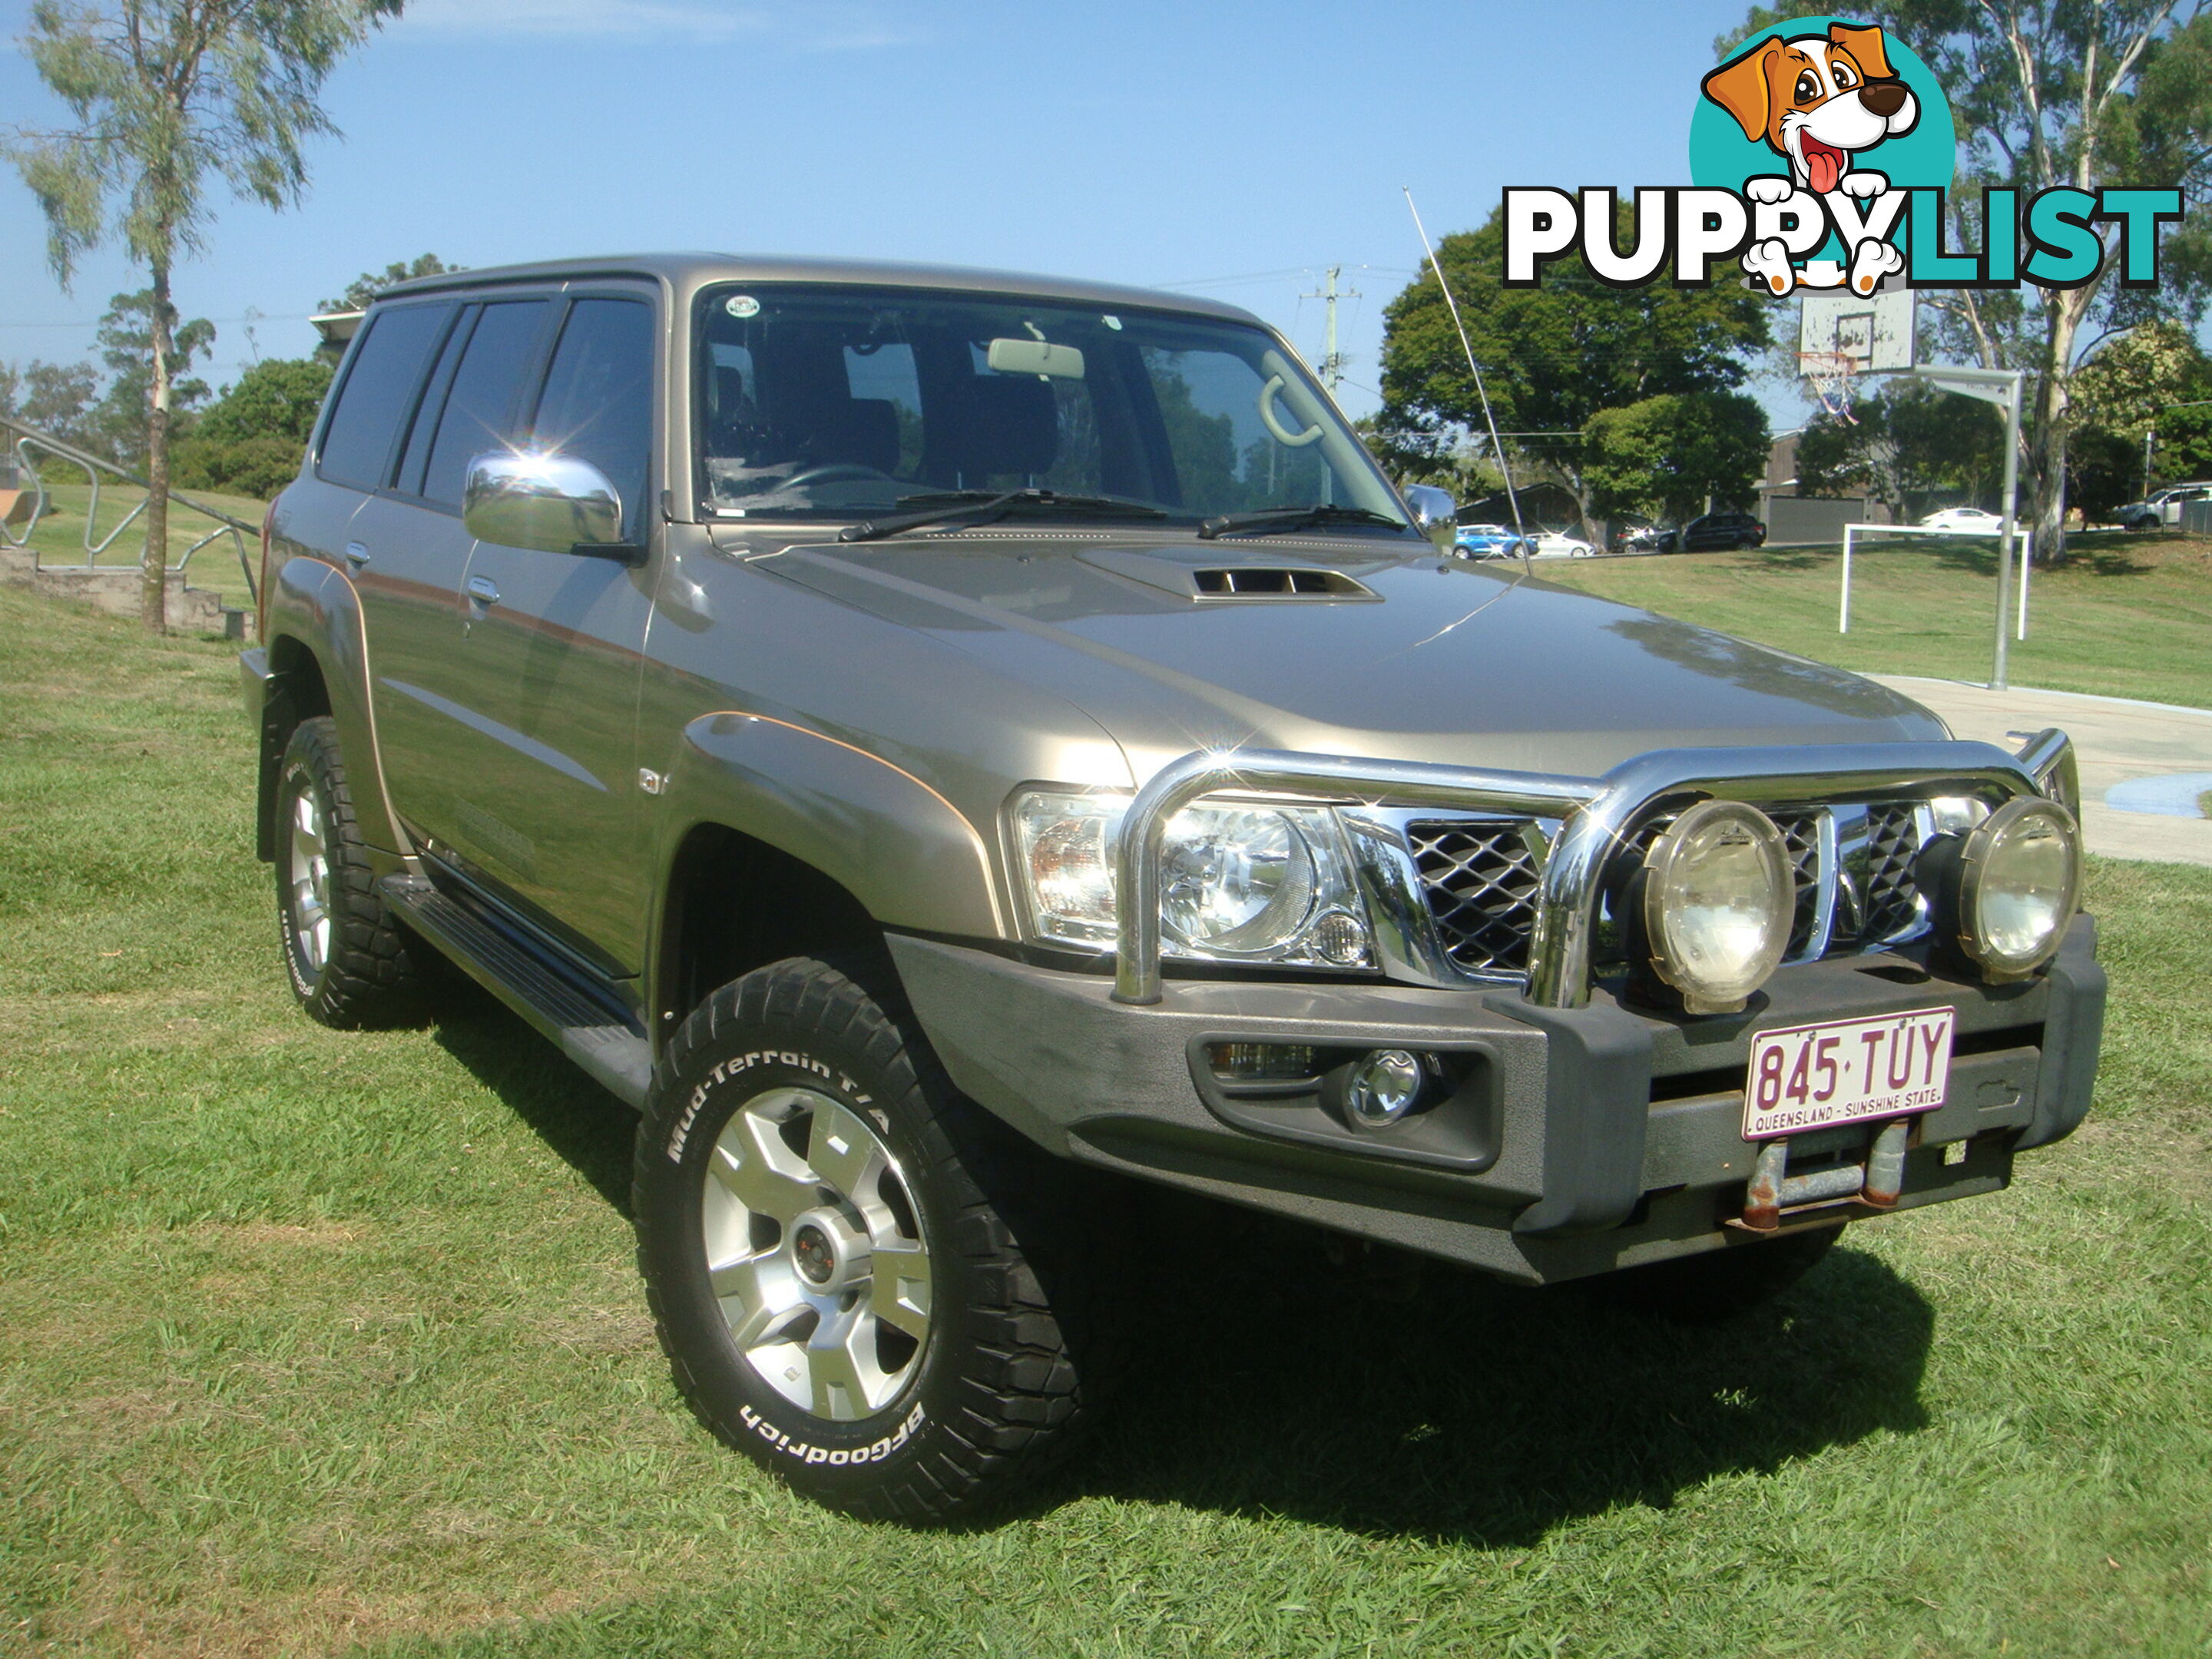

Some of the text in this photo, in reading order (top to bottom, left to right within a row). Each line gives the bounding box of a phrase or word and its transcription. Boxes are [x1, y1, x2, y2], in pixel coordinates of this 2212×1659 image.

[667, 1050, 890, 1164] Mud-Terrain T/A
[1755, 1105, 1833, 1131] QUEENSLAND
[1845, 1094, 1900, 1117] SUNSHINE
[1905, 1088, 1937, 1107] STATE
[740, 1401, 926, 1465] BFGoodrich
